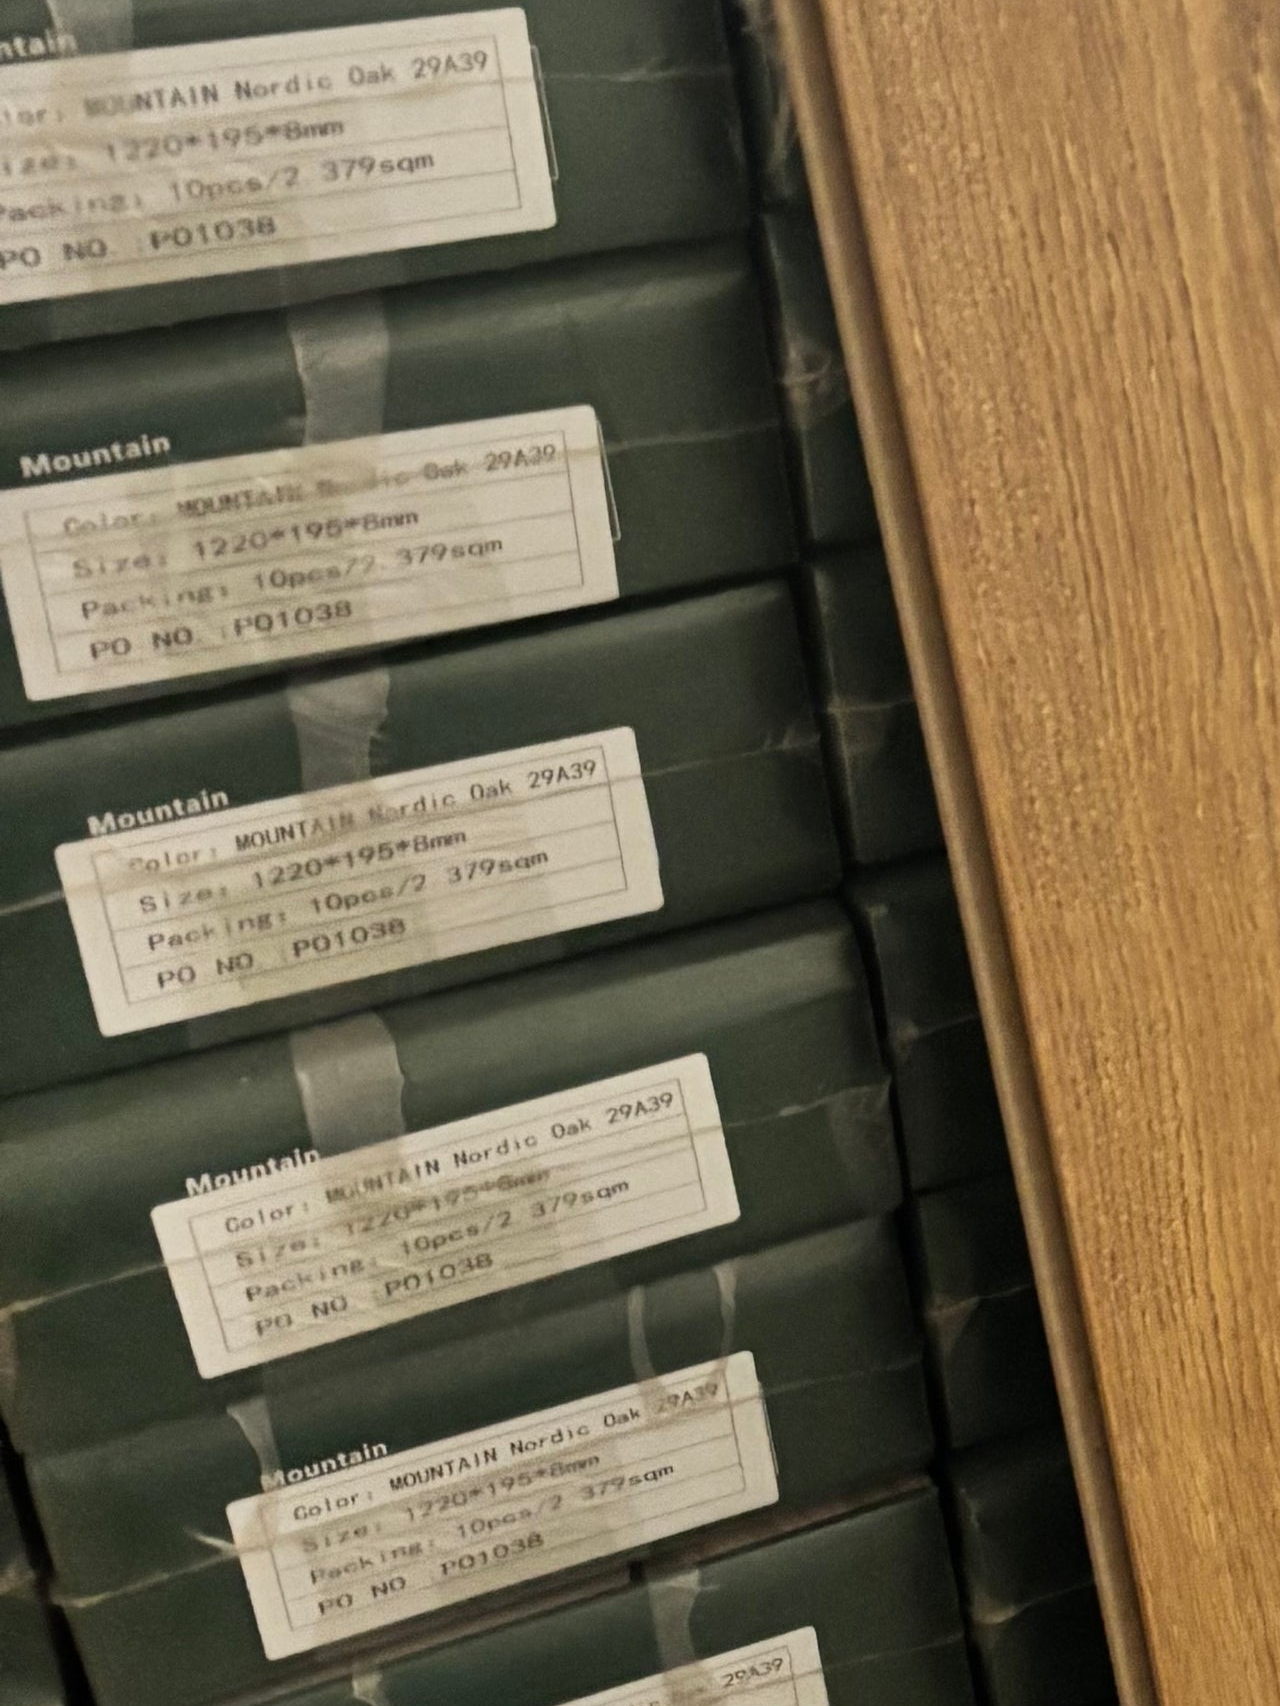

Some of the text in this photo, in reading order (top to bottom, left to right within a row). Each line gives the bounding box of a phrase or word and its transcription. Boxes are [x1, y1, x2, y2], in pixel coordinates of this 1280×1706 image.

[235, 75, 333, 103] Nordic
[348, 65, 396, 88] Oak
[412, 50, 488, 79] 29A39
[19, 435, 172, 479] Mountain
[485, 442, 557, 474] 29A39
[89, 637, 132, 661] PO
[86, 788, 230, 837] Mountain
[234, 811, 355, 853] MOUNTAIN
[368, 792, 456, 828] Nordic
[469, 779, 512, 805] Oak
[526, 758, 598, 791] 29A39
[140, 881, 229, 915] Size:
[148, 908, 288, 951] Packing:
[156, 965, 196, 990] PO
[325, 1158, 441, 1206] MOUNTAIN
[453, 1133, 538, 1170] Nordic
[551, 1118, 592, 1142] Oak
[606, 1091, 674, 1126] 29A39
[185, 1147, 320, 1197] Mountain
[255, 1312, 293, 1338] PO
[270, 1442, 388, 1489] Mountain
[389, 1446, 498, 1491] MOUNTAIN
[509, 1421, 591, 1456] Nordic
[602, 1407, 642, 1430] Oak
[318, 1593, 354, 1617] PO
[722, 1657, 785, 1689] 29A39
